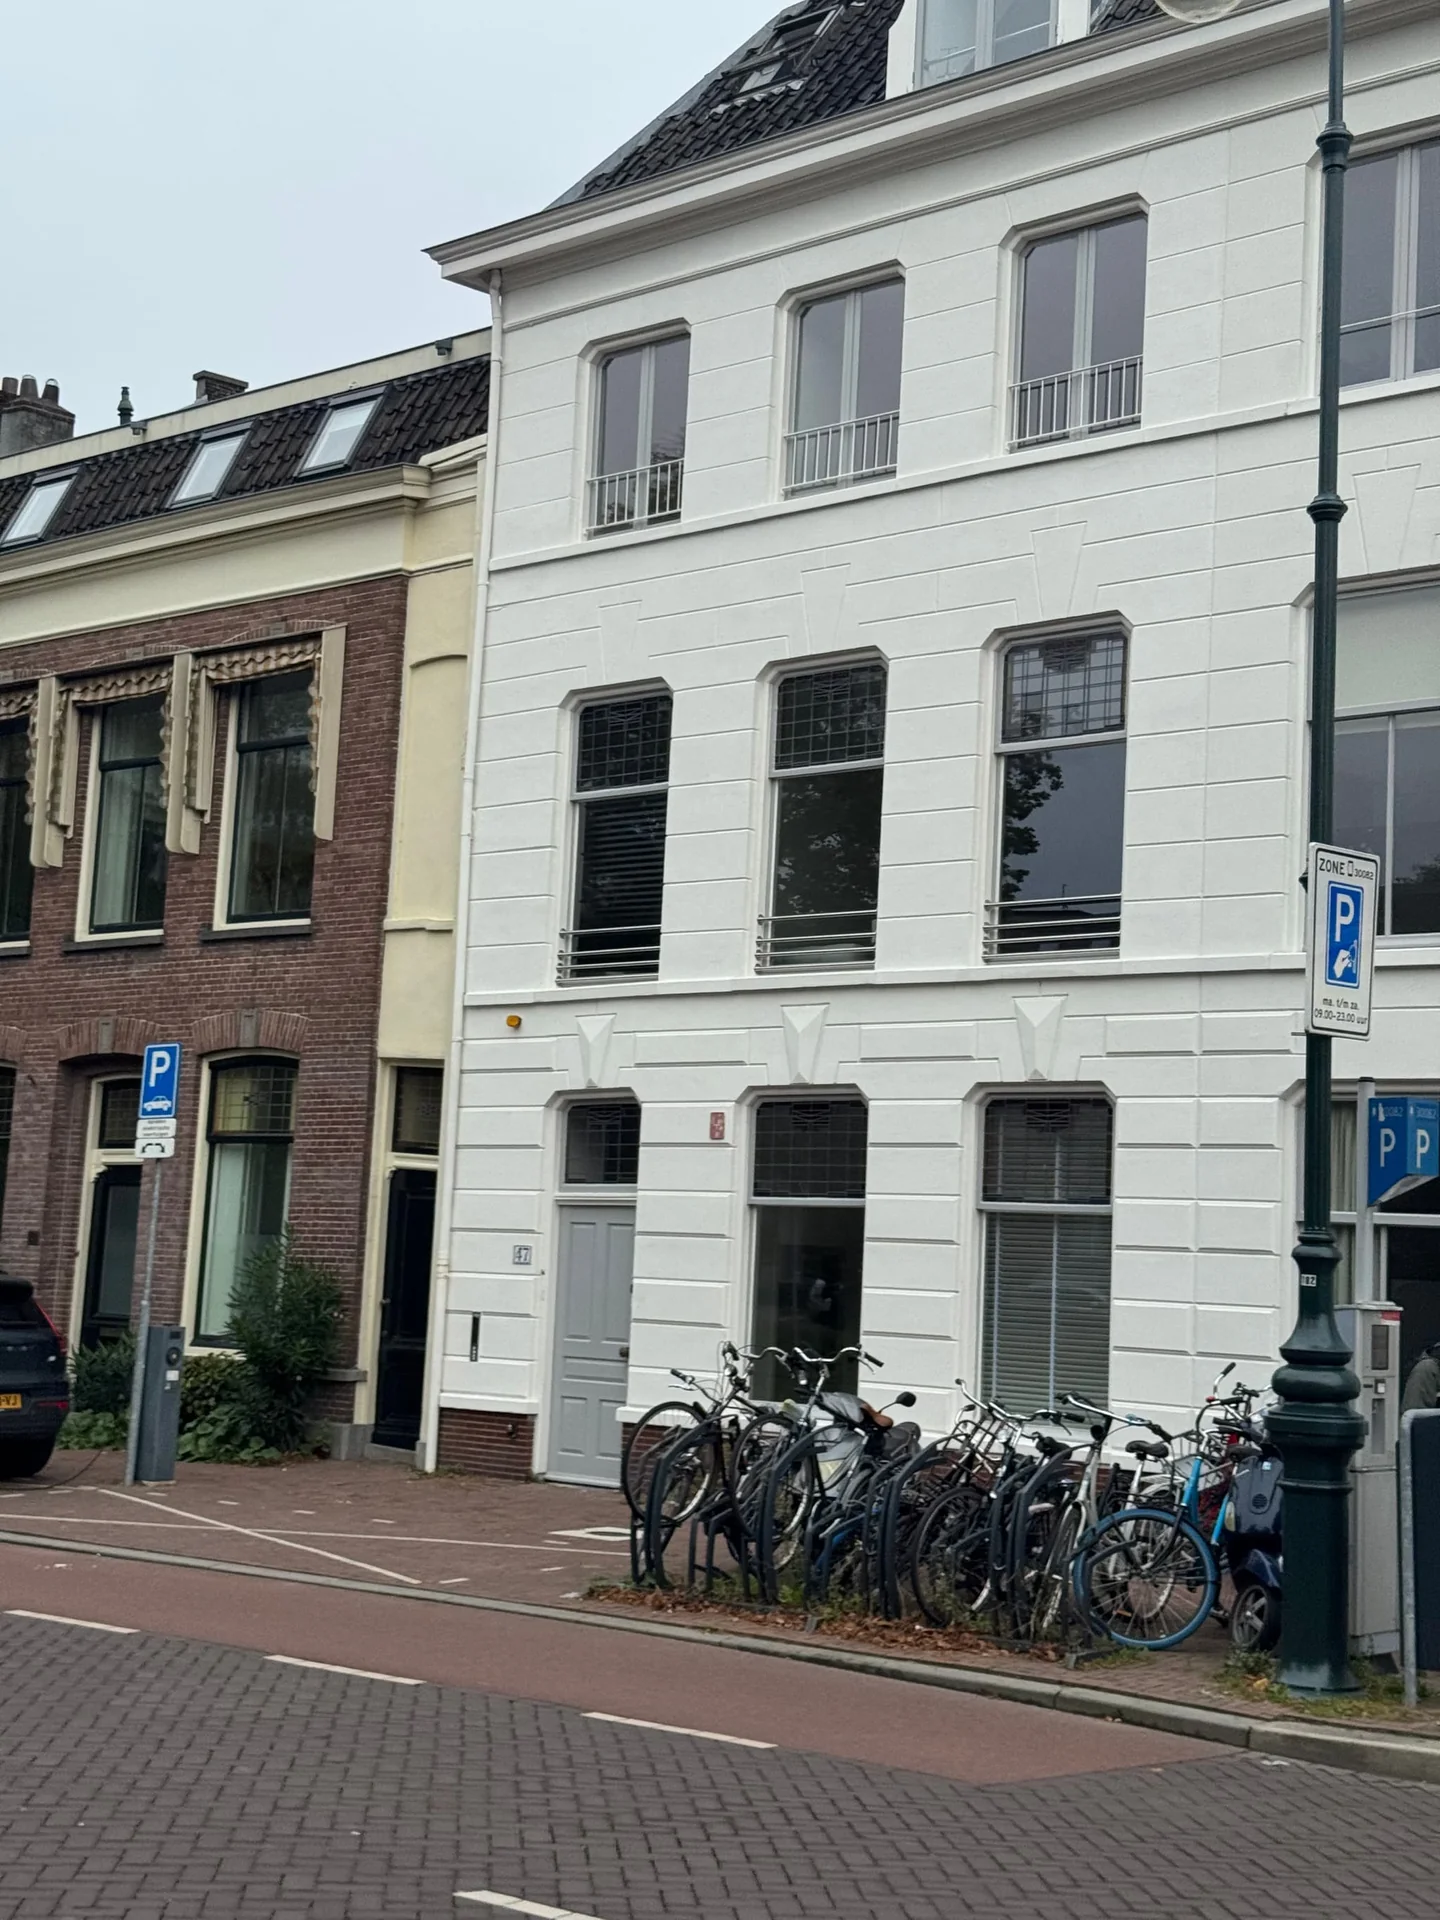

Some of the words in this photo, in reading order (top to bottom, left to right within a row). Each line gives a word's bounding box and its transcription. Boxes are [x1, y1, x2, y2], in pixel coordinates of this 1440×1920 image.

[1319, 857, 1345, 876] ZONE
[1335, 893, 1354, 942] P
[149, 1051, 170, 1087] P
[1381, 1128, 1395, 1167] P
[1416, 1128, 1430, 1168] P
[515, 1247, 529, 1262] 47
